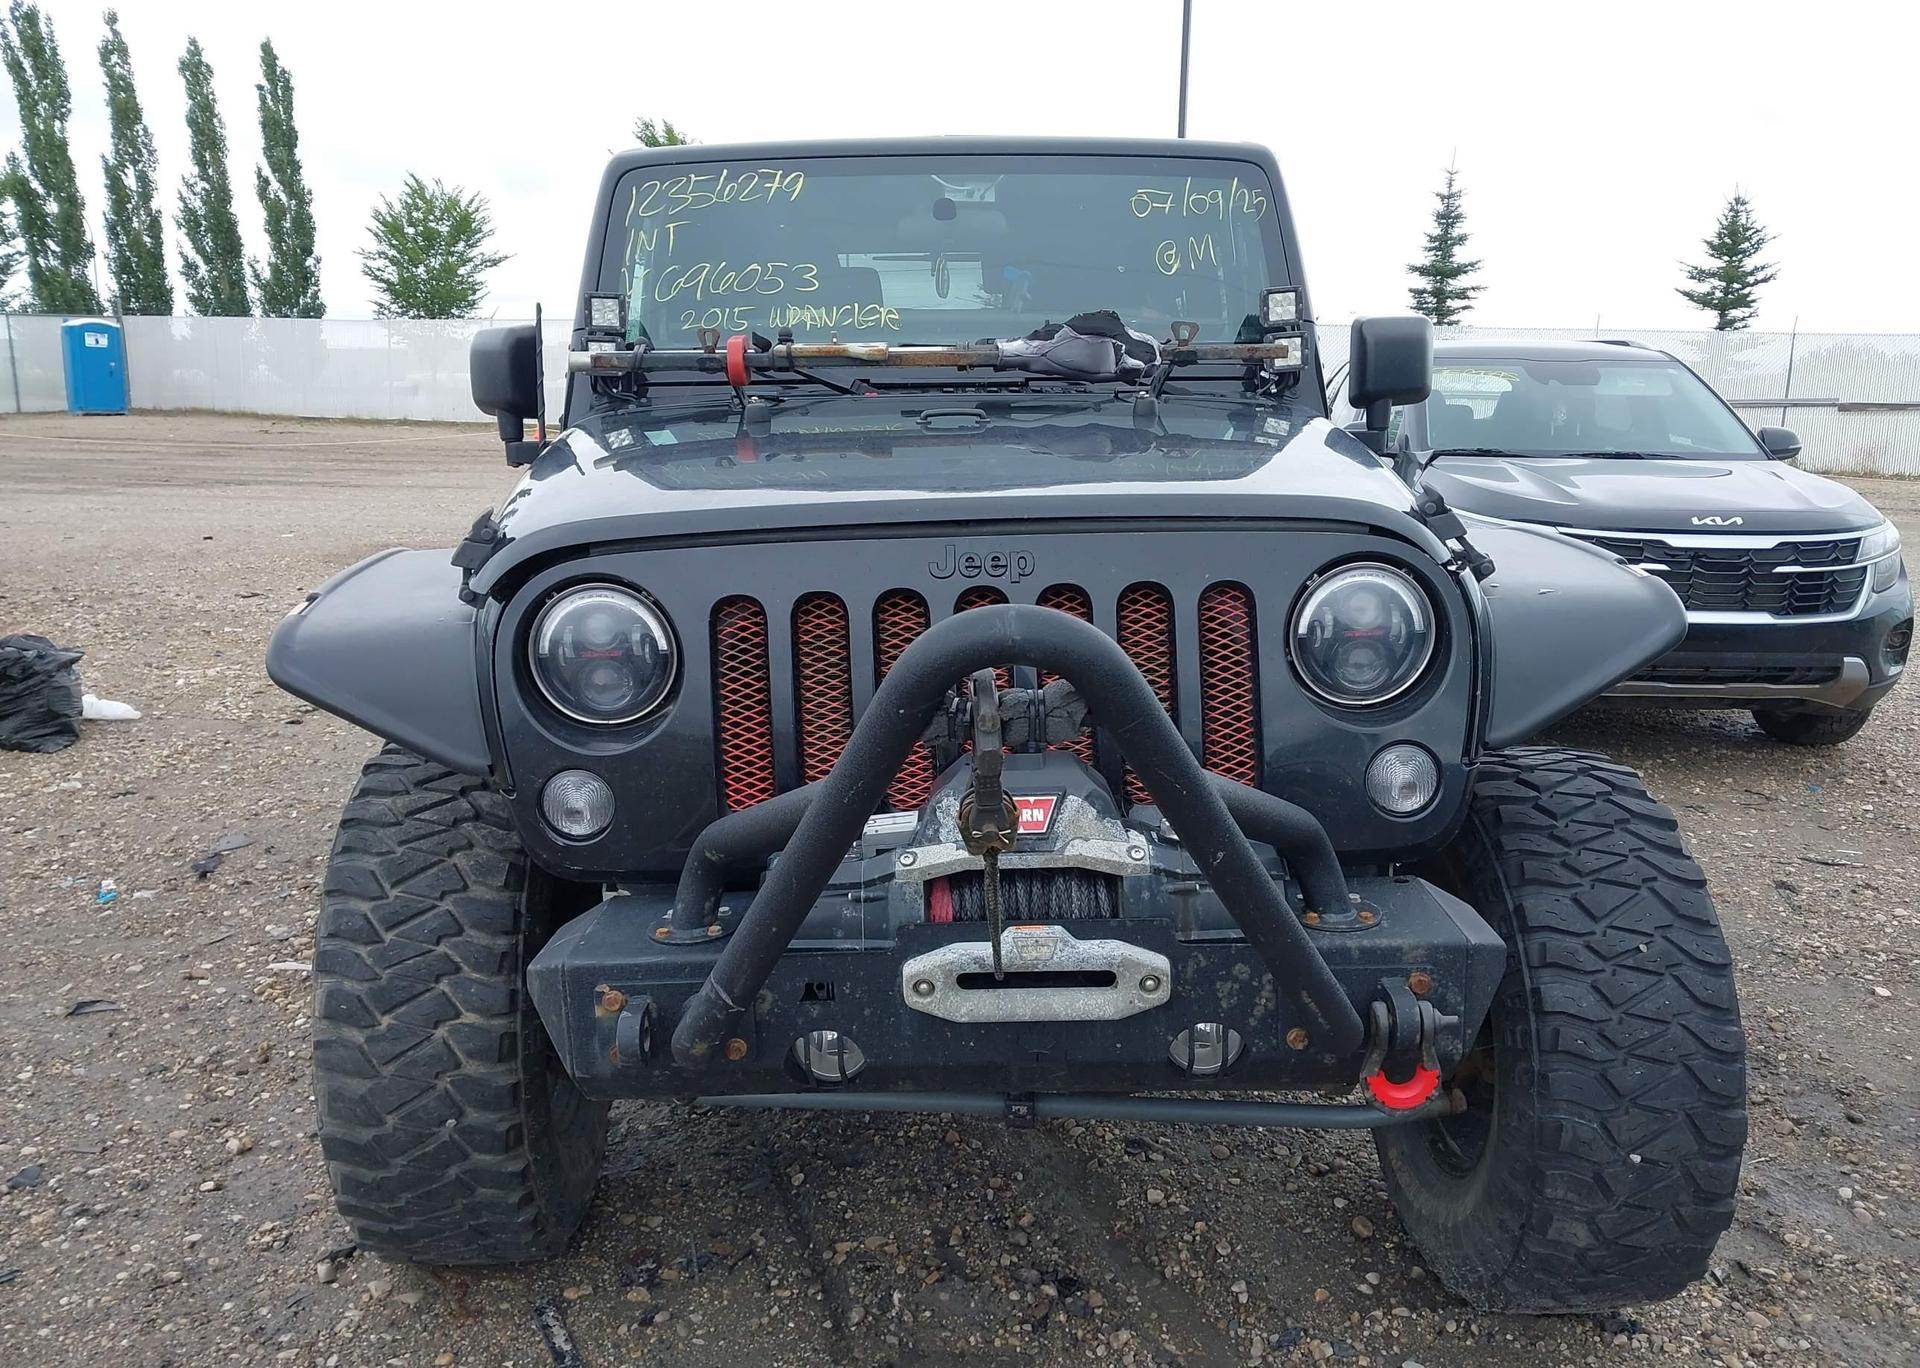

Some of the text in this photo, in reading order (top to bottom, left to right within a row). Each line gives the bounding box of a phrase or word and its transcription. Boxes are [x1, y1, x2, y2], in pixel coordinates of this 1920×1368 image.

[625, 168, 804, 226] 12356279
[1129, 176, 1267, 226] 07/09/25
[626, 221, 692, 266] INT
[681, 306, 756, 332] 2015
[928, 544, 1036, 584] Jeep
[1019, 808, 1044, 823] RN
